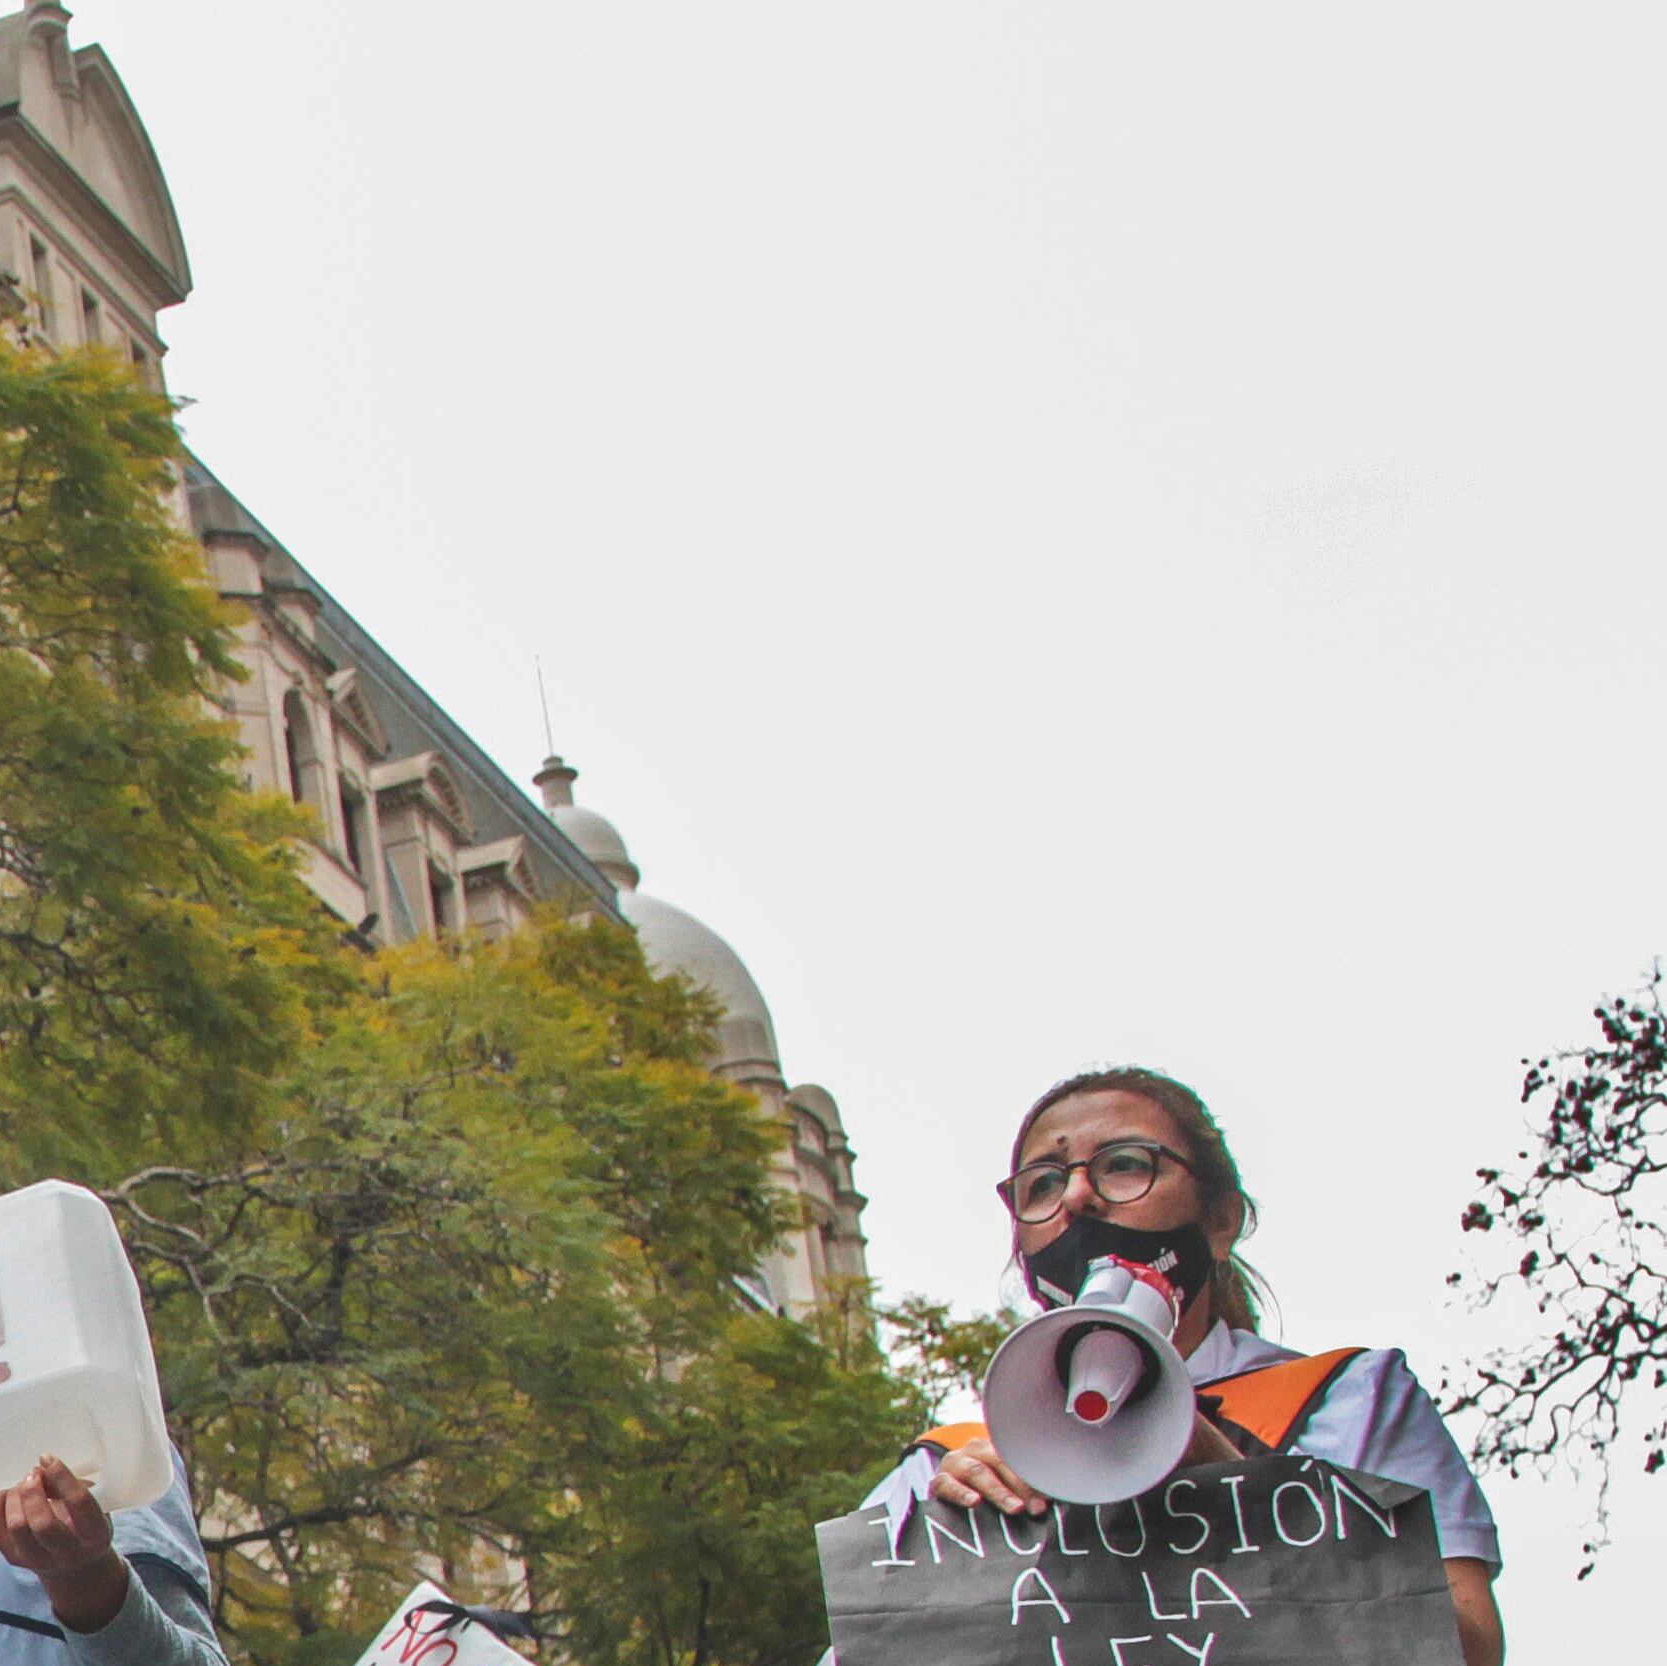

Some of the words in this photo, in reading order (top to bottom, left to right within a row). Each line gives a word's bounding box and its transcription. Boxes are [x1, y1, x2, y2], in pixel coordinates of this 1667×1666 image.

[867, 1456, 1399, 1567] INCLUSIÓN
[1011, 1566, 1070, 1626] A
[1142, 1566, 1253, 1622] LA
